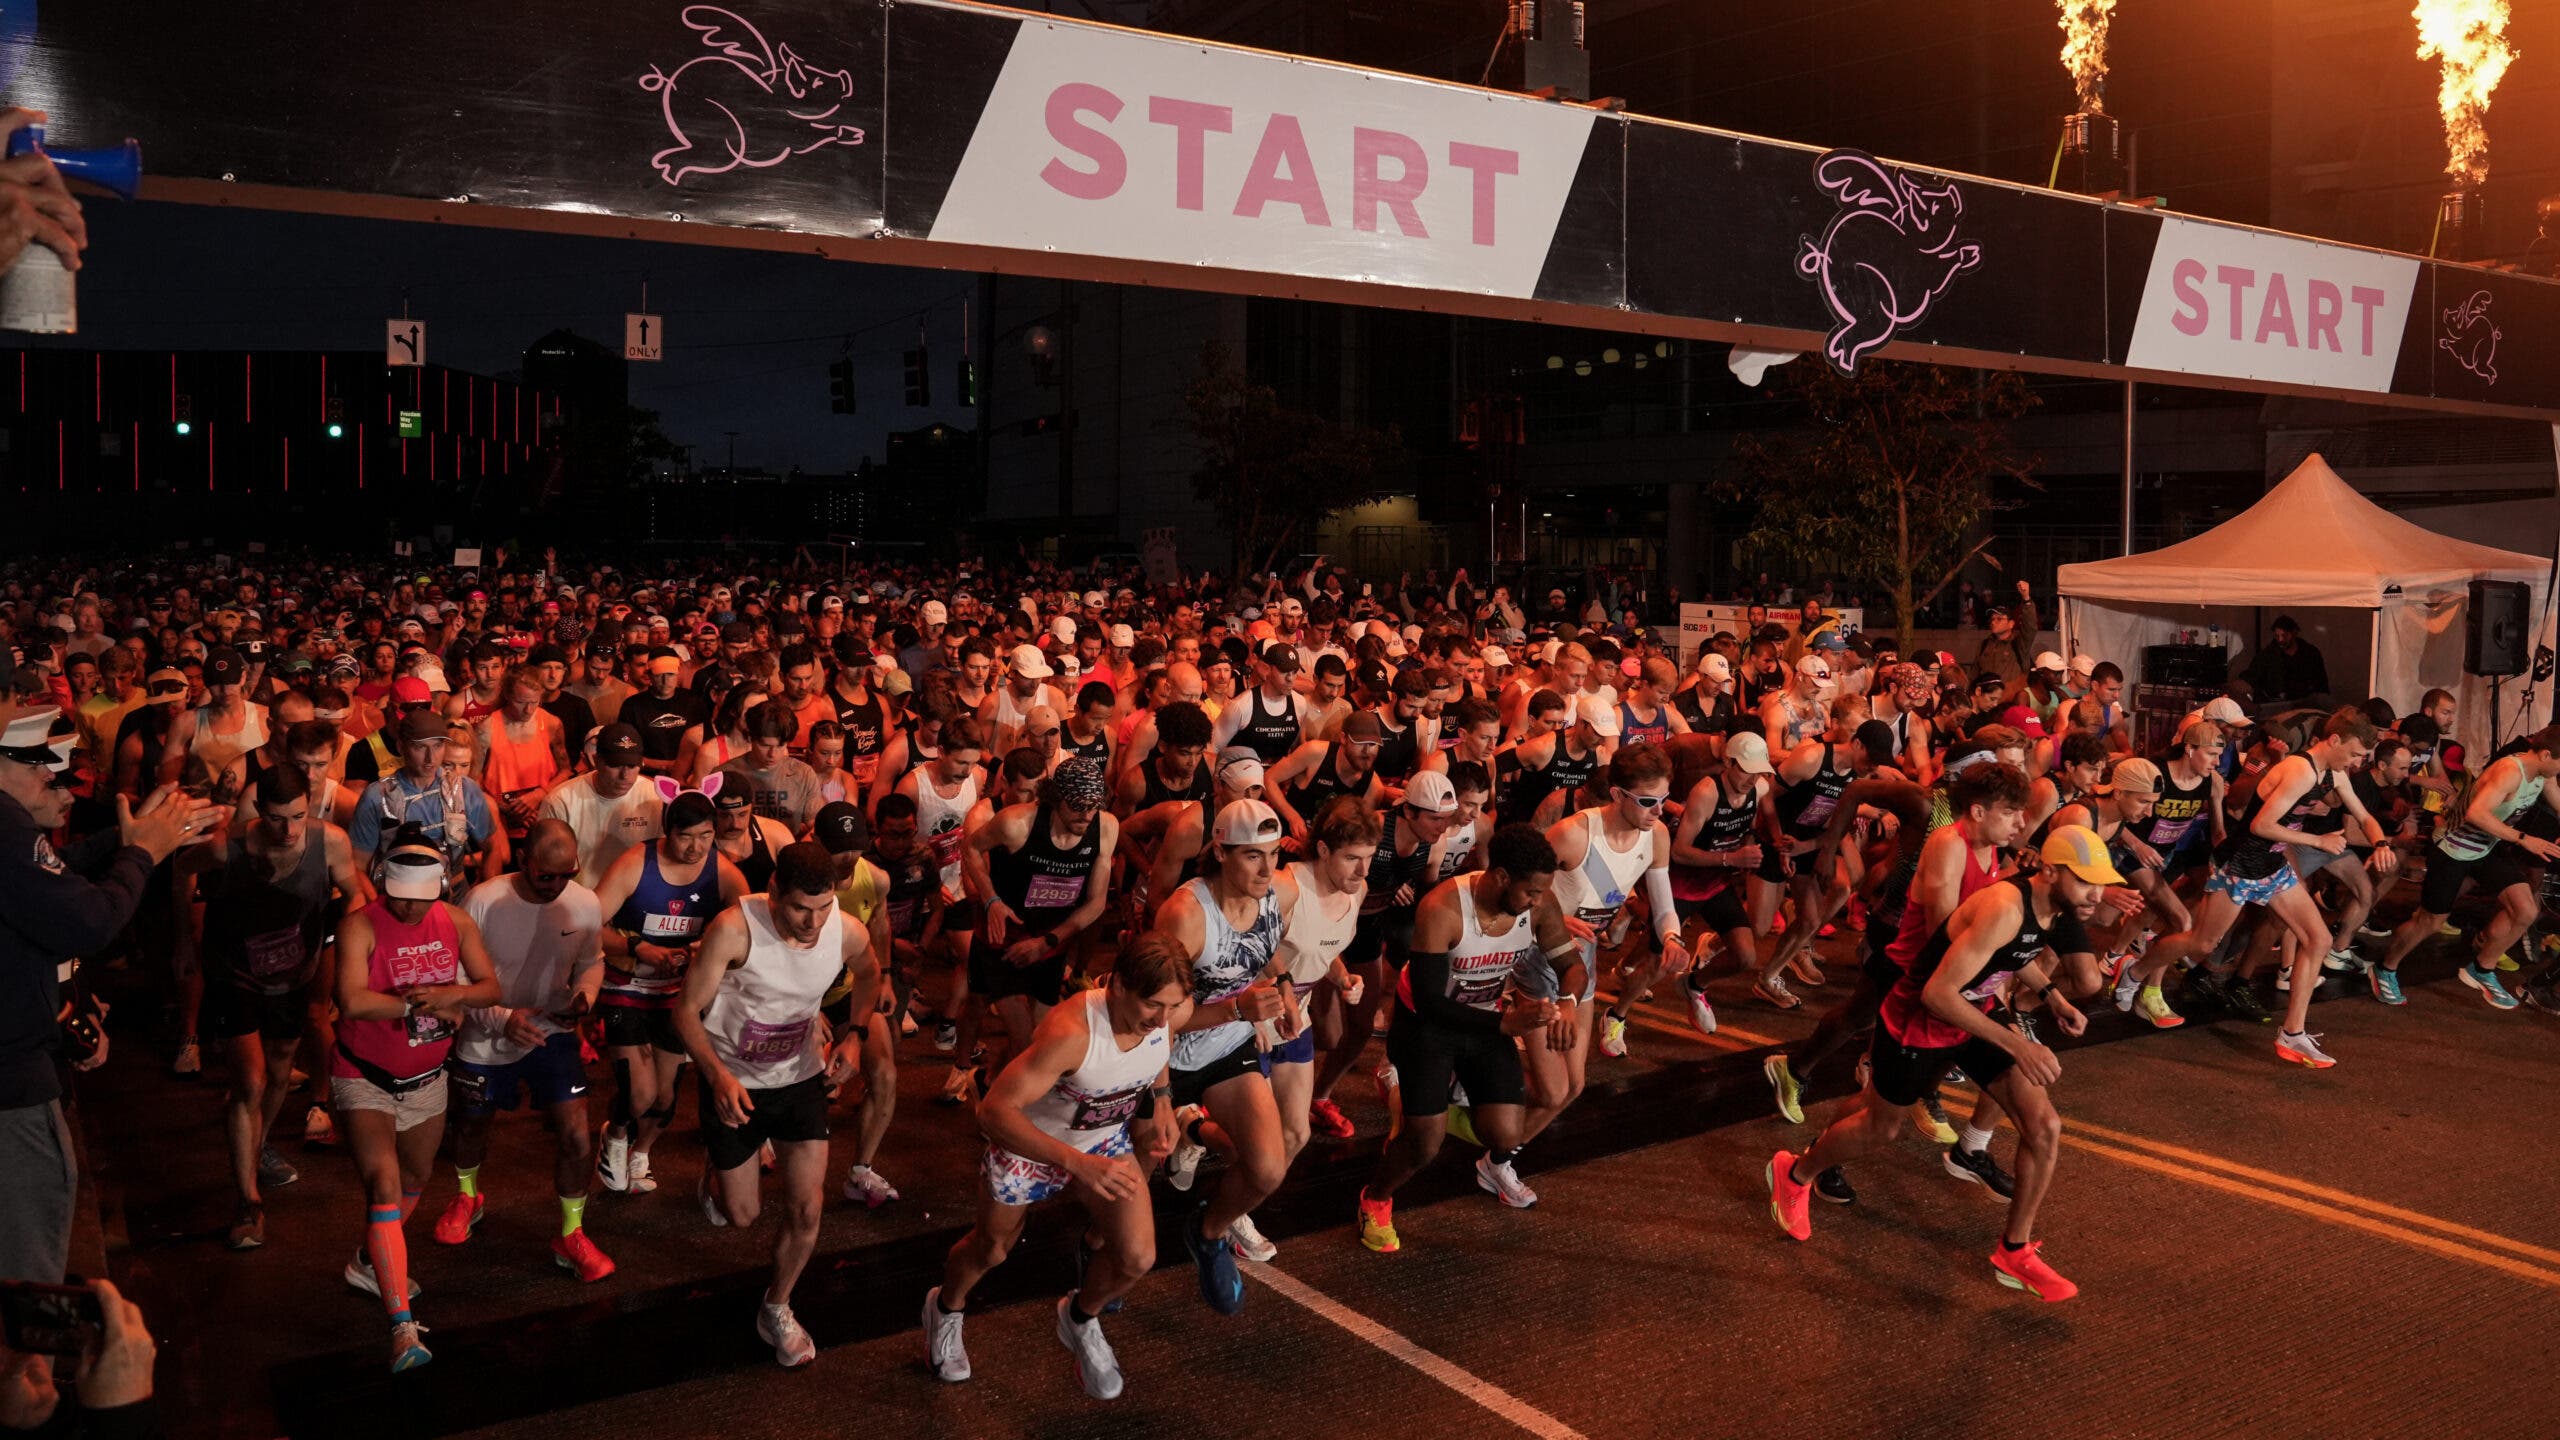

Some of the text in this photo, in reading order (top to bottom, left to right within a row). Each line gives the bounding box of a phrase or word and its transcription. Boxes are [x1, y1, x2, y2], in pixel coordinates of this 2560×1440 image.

[1039, 81, 1519, 247] START
[2171, 258, 2384, 356] START
[629, 346, 658, 358] ONLY
[1769, 611, 1801, 621] AIRMAN
[754, 790, 788, 804] EEP
[2155, 798, 2202, 810] STAR
[1029, 854, 1091, 869] CINCINNATUS
[1046, 865, 1073, 876] ELITE
[1031, 887, 1078, 900] 12951
[658, 917, 694, 932] ALLEN
[397, 940, 443, 957] FLYING
